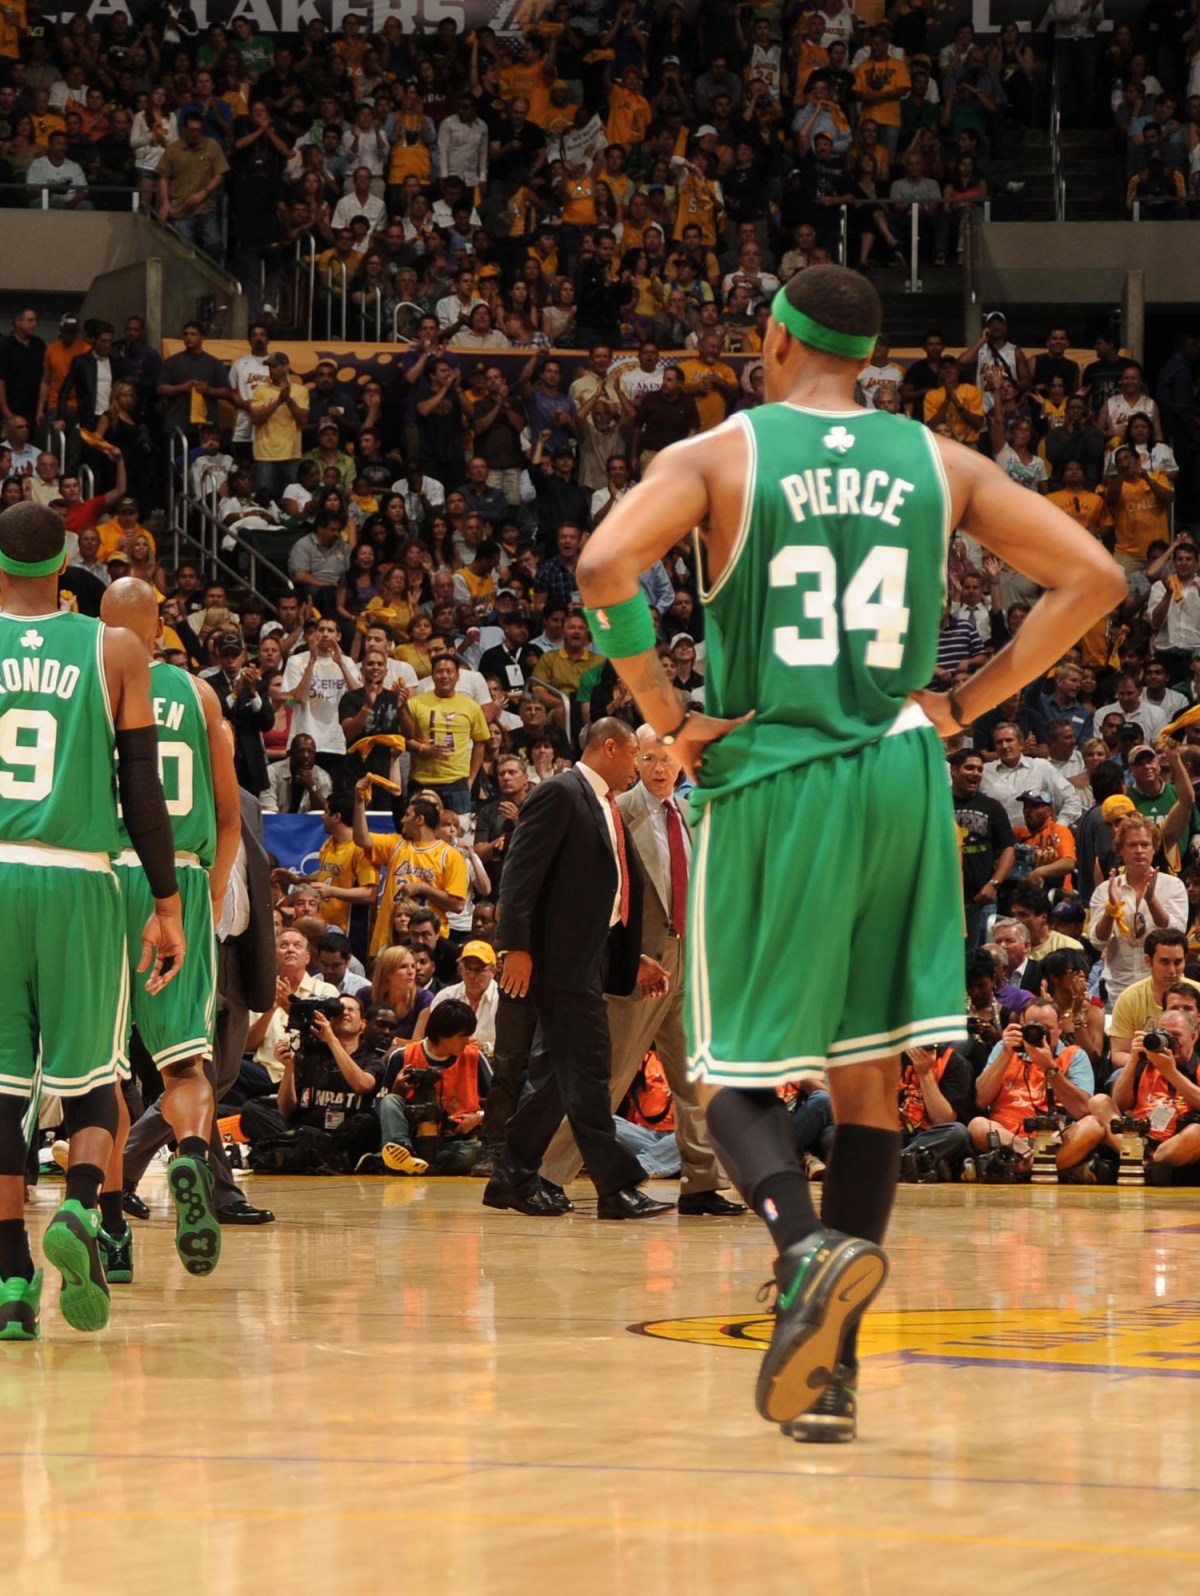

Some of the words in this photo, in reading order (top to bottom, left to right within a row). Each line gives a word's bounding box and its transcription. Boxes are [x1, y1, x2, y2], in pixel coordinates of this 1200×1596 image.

[779, 467, 916, 528] PIERCE
[768, 545, 910, 670] 34
[153, 697, 185, 731] EN
[394, 860, 434, 884] LAKERS
